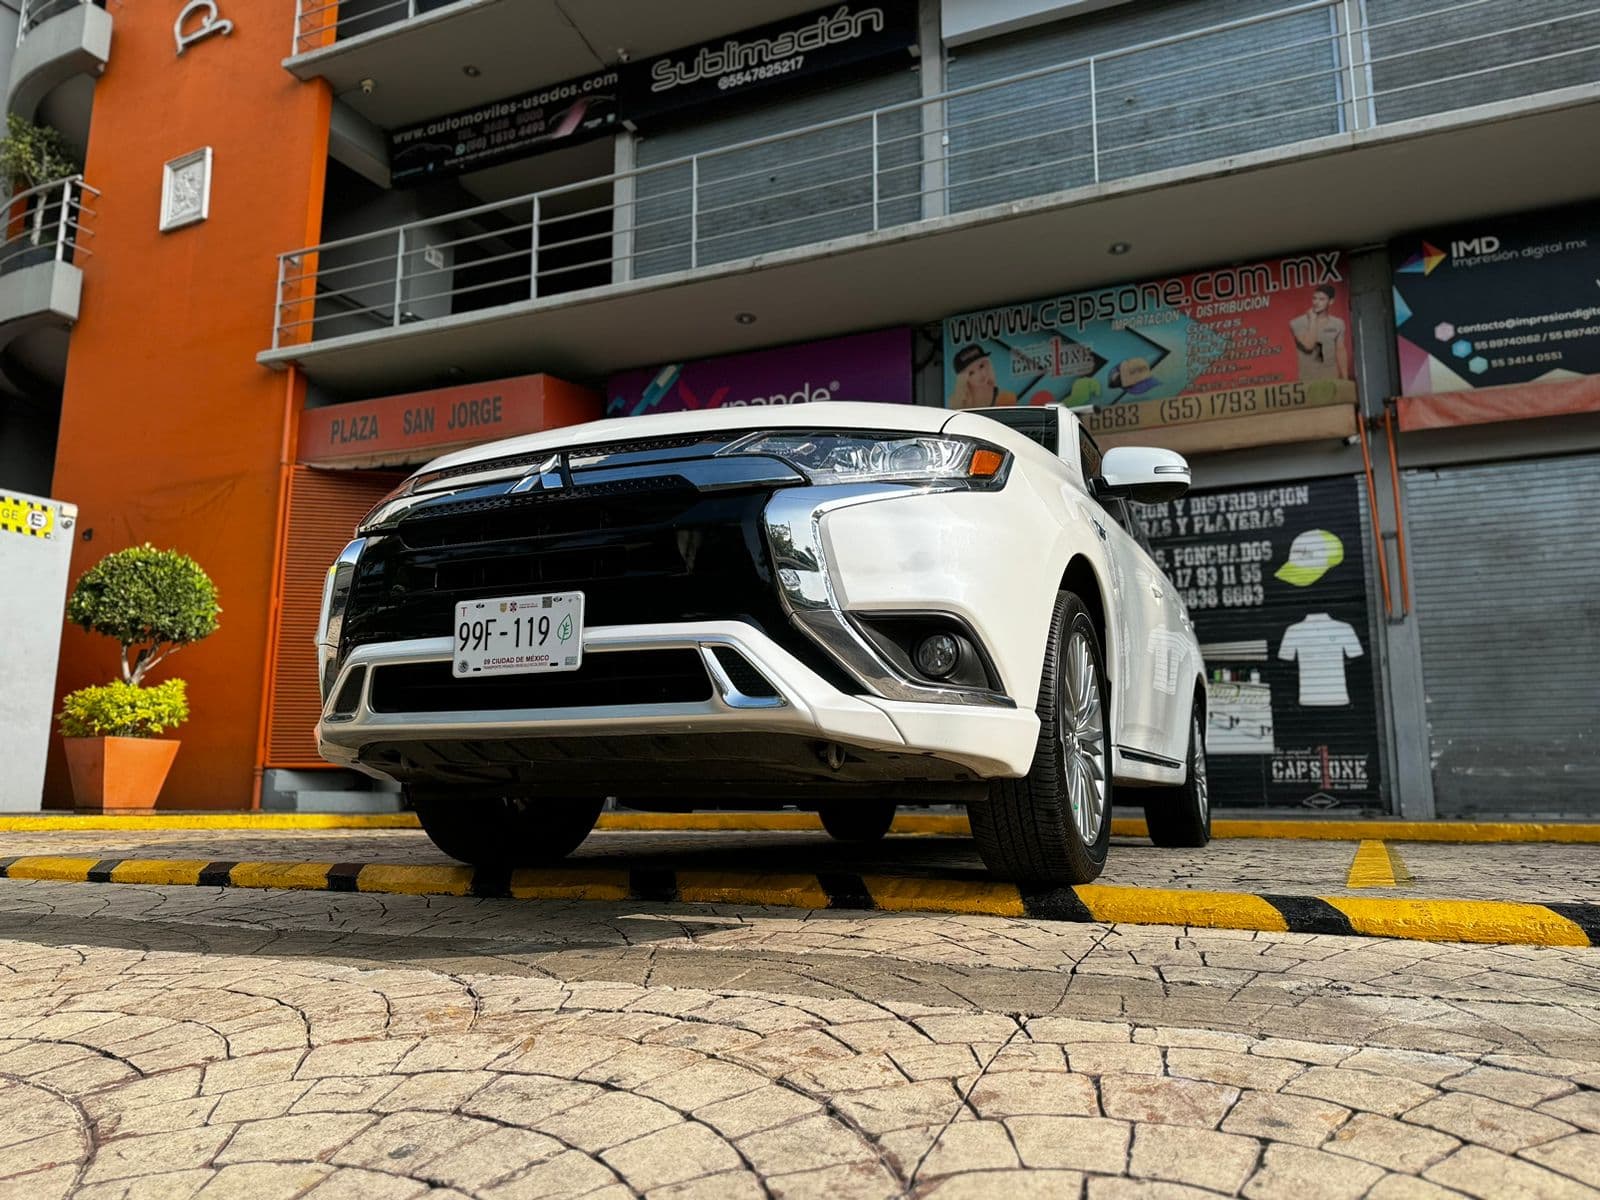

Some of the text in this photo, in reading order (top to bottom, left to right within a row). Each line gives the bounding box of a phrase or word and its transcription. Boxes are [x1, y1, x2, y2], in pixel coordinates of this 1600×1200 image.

[651, 6, 883, 93] Sublimación
[393, 72, 618, 144] www.automoviles-usados.com
[1451, 236, 1500, 258] IMD
[1521, 241, 1562, 259] digital
[1566, 239, 1588, 251] mx
[950, 251, 1342, 345] www.capsone.com.mx
[1196, 295, 1270, 318] DISTRIBUCION
[1160, 394, 1203, 423] (55)
[1209, 388, 1257, 415] 1793
[1264, 382, 1306, 409] 1155
[330, 396, 502, 445] PLAZA SAN JORGE
[1174, 500, 1186, 516] Y
[1191, 486, 1309, 515] DISTRIBUCION
[1176, 517, 1188, 535] Y
[1193, 508, 1286, 534] PLAYERAS
[459, 615, 550, 652] 99F-119
[492, 656, 514, 665] CIUDAD
[516, 655, 524, 663] DE
